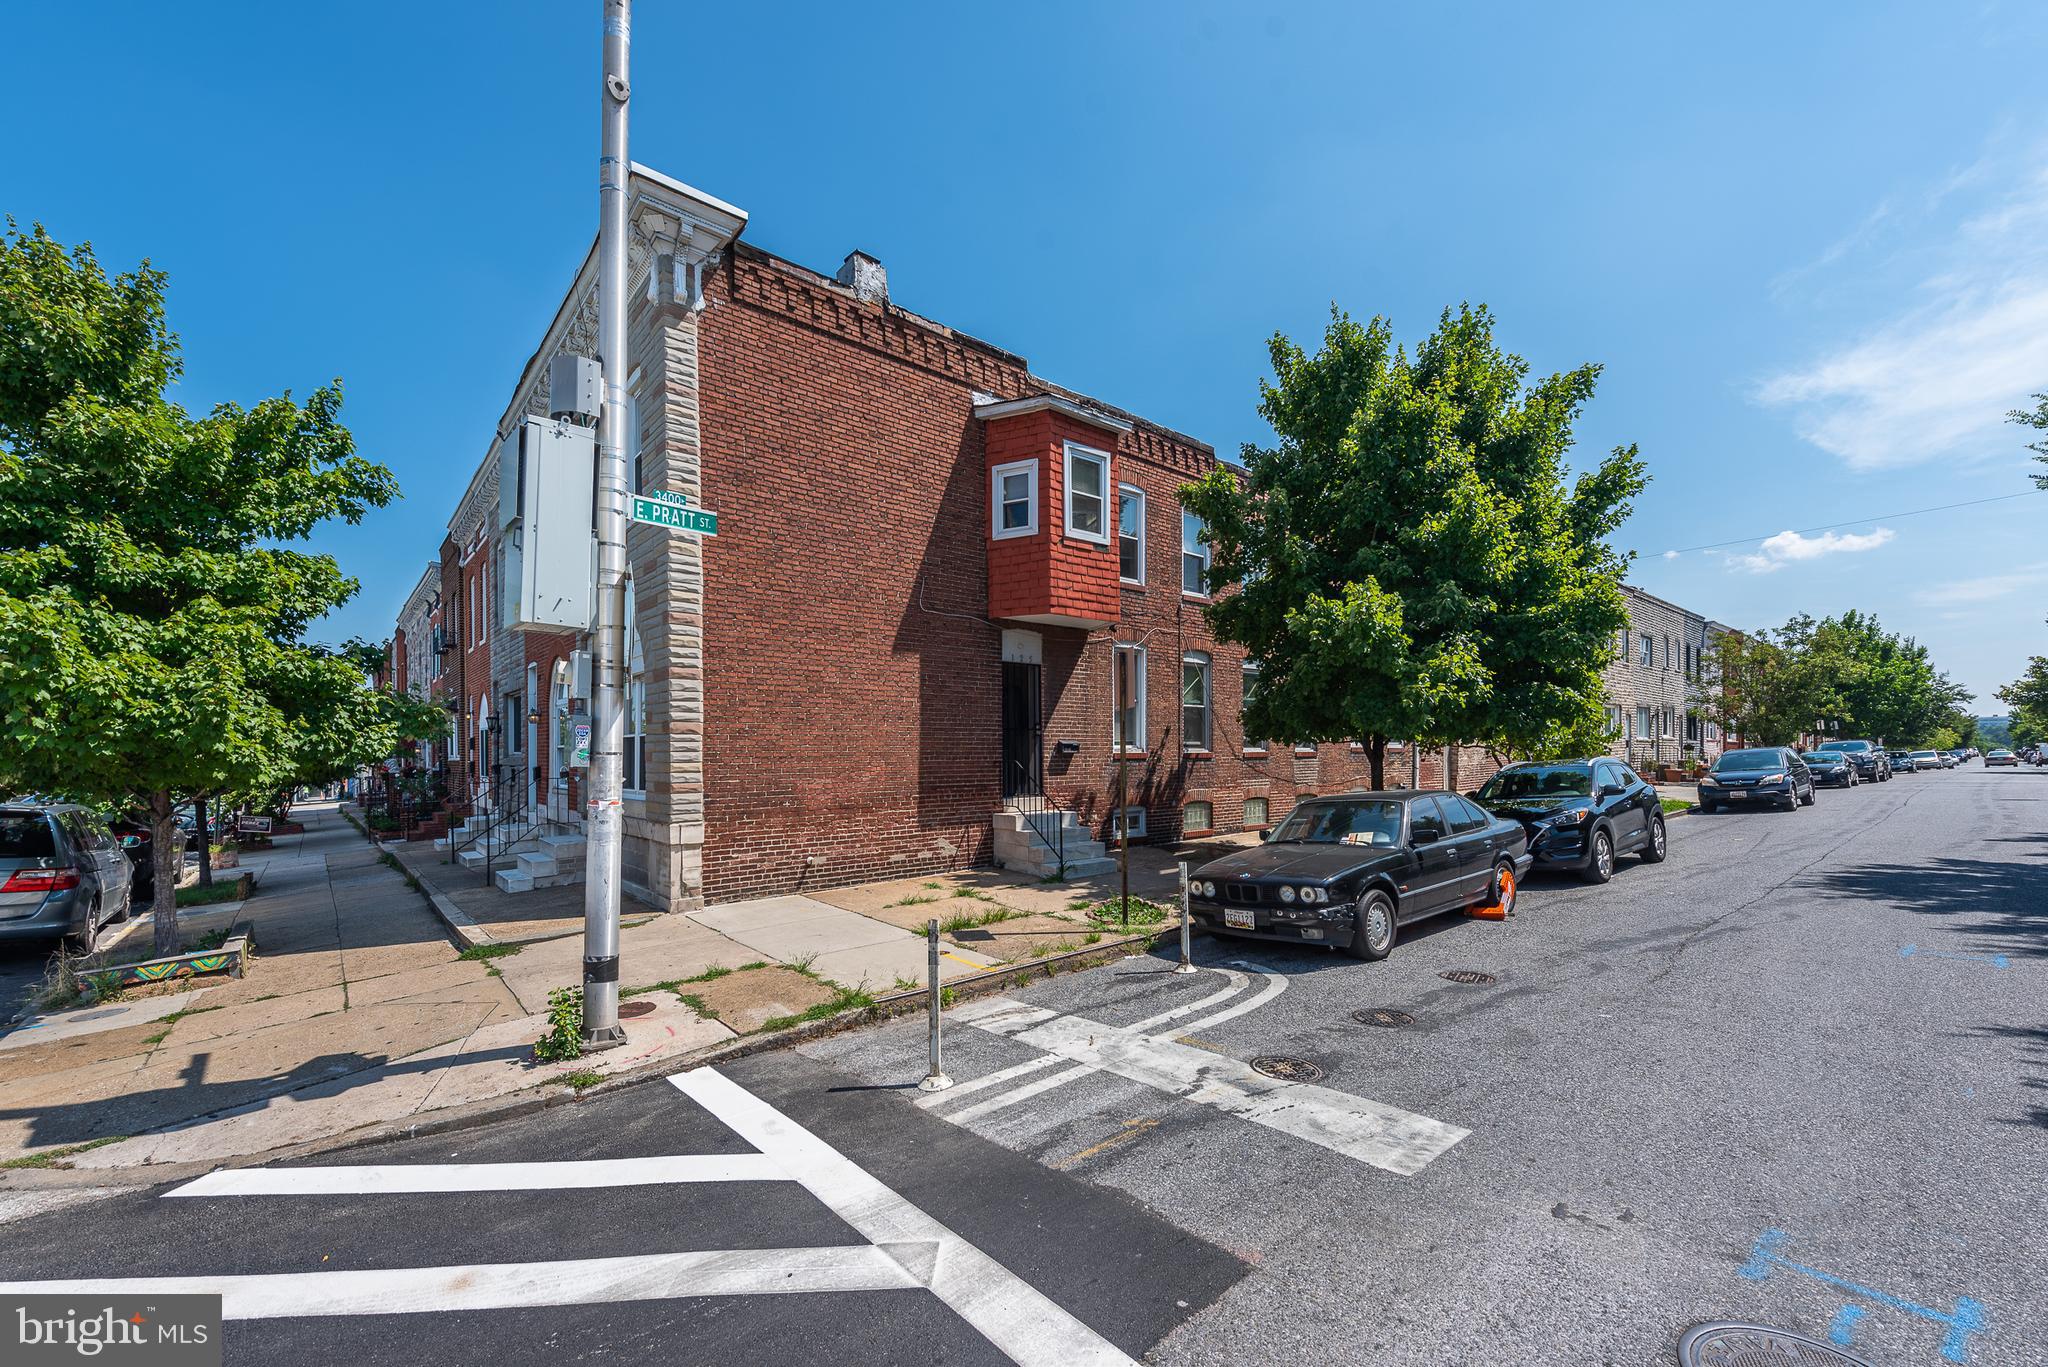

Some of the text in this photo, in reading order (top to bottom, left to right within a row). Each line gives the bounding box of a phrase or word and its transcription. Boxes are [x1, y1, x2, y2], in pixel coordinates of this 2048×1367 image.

[636, 502, 712, 529] E. PRATT ST.
